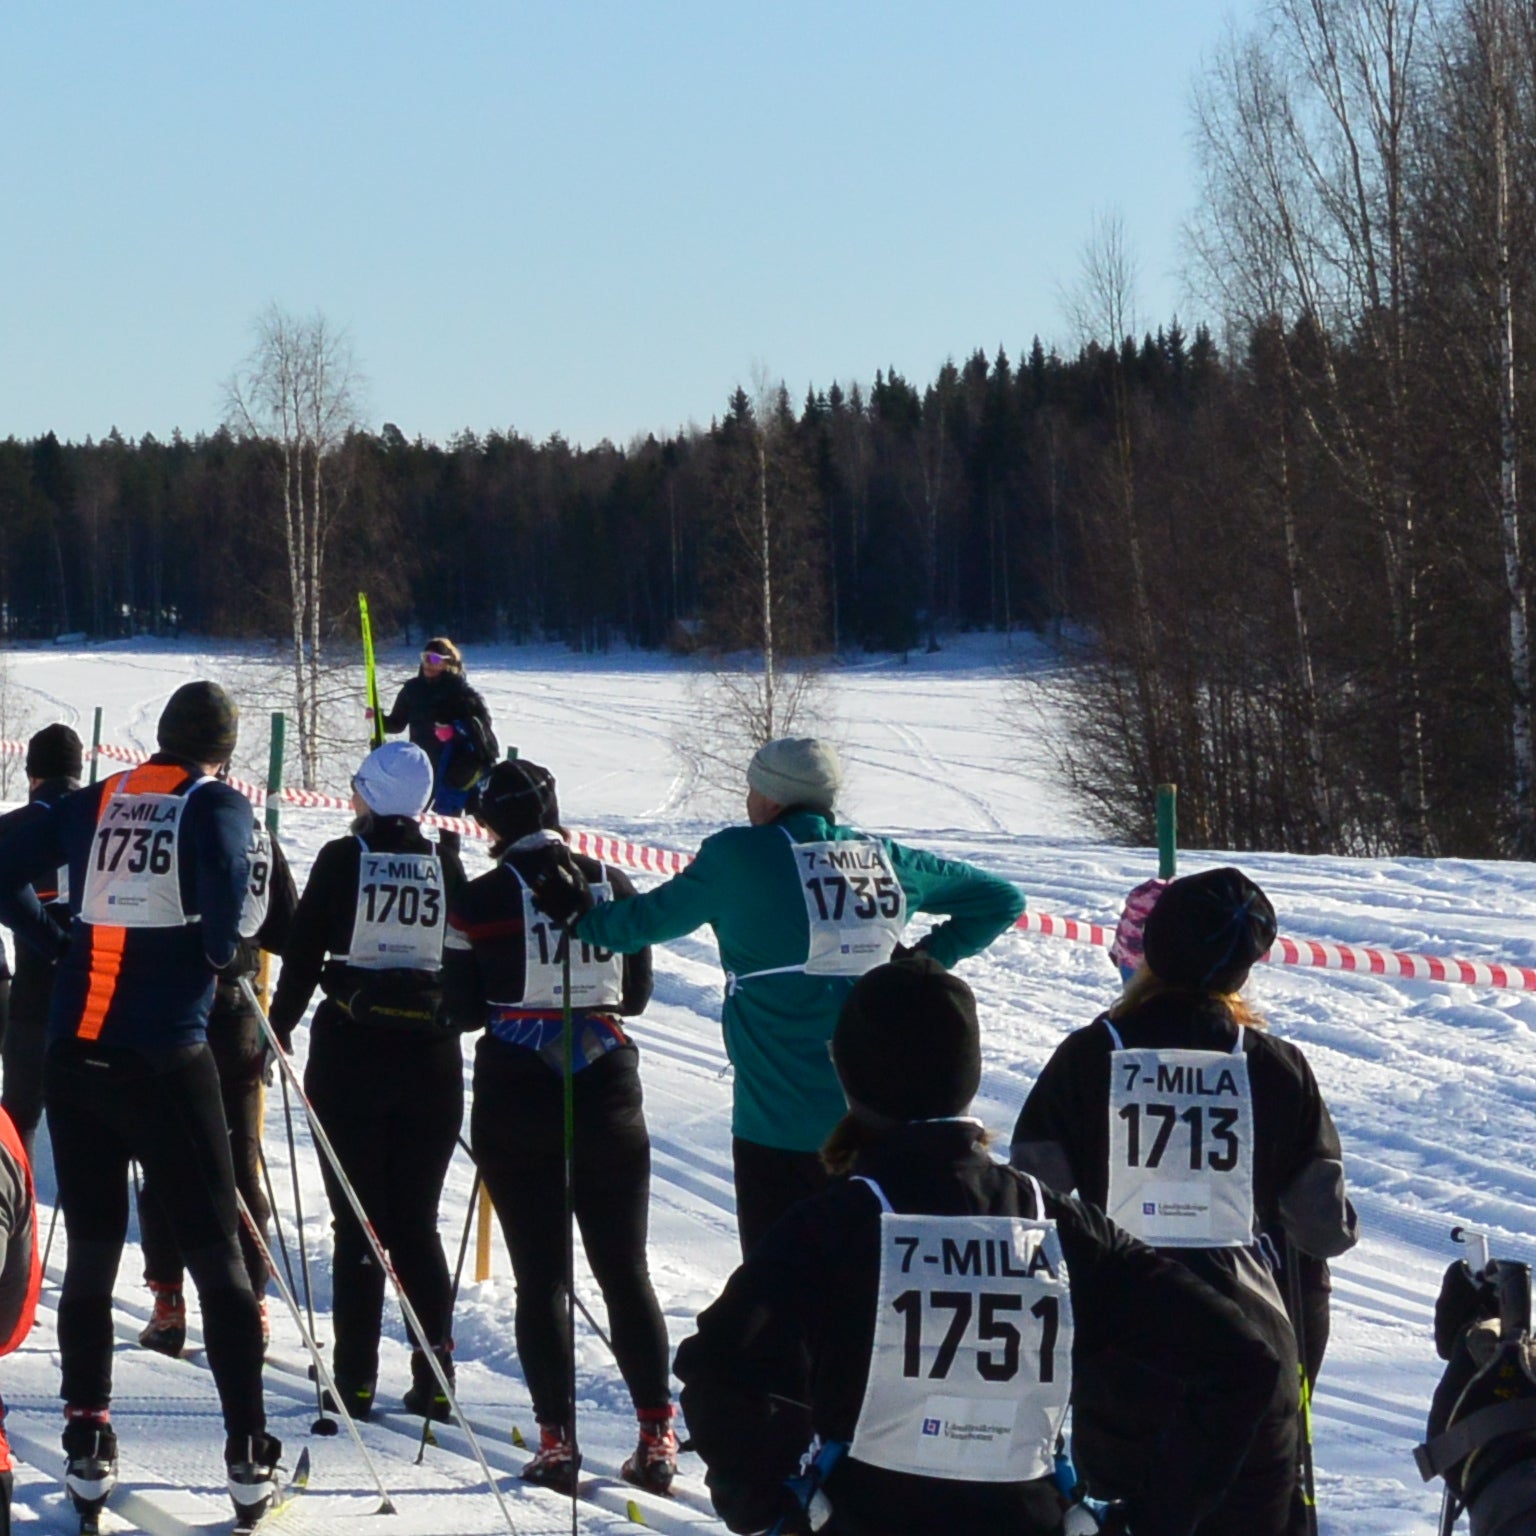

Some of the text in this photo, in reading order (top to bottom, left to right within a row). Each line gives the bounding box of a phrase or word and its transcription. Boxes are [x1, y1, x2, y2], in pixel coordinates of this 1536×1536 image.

[109, 802, 177, 823] 7-MILA
[96, 827, 174, 875] 1736
[366, 861, 438, 883] 7-MILA
[803, 850, 887, 871] 7-MILA
[361, 883, 441, 928] 1703
[806, 876, 901, 921] 1735
[1122, 1064, 1240, 1097] 7-MILA
[1118, 1102, 1240, 1172] 1713
[893, 1236, 1060, 1280] 7-MILA
[891, 1289, 1059, 1383] 1751
